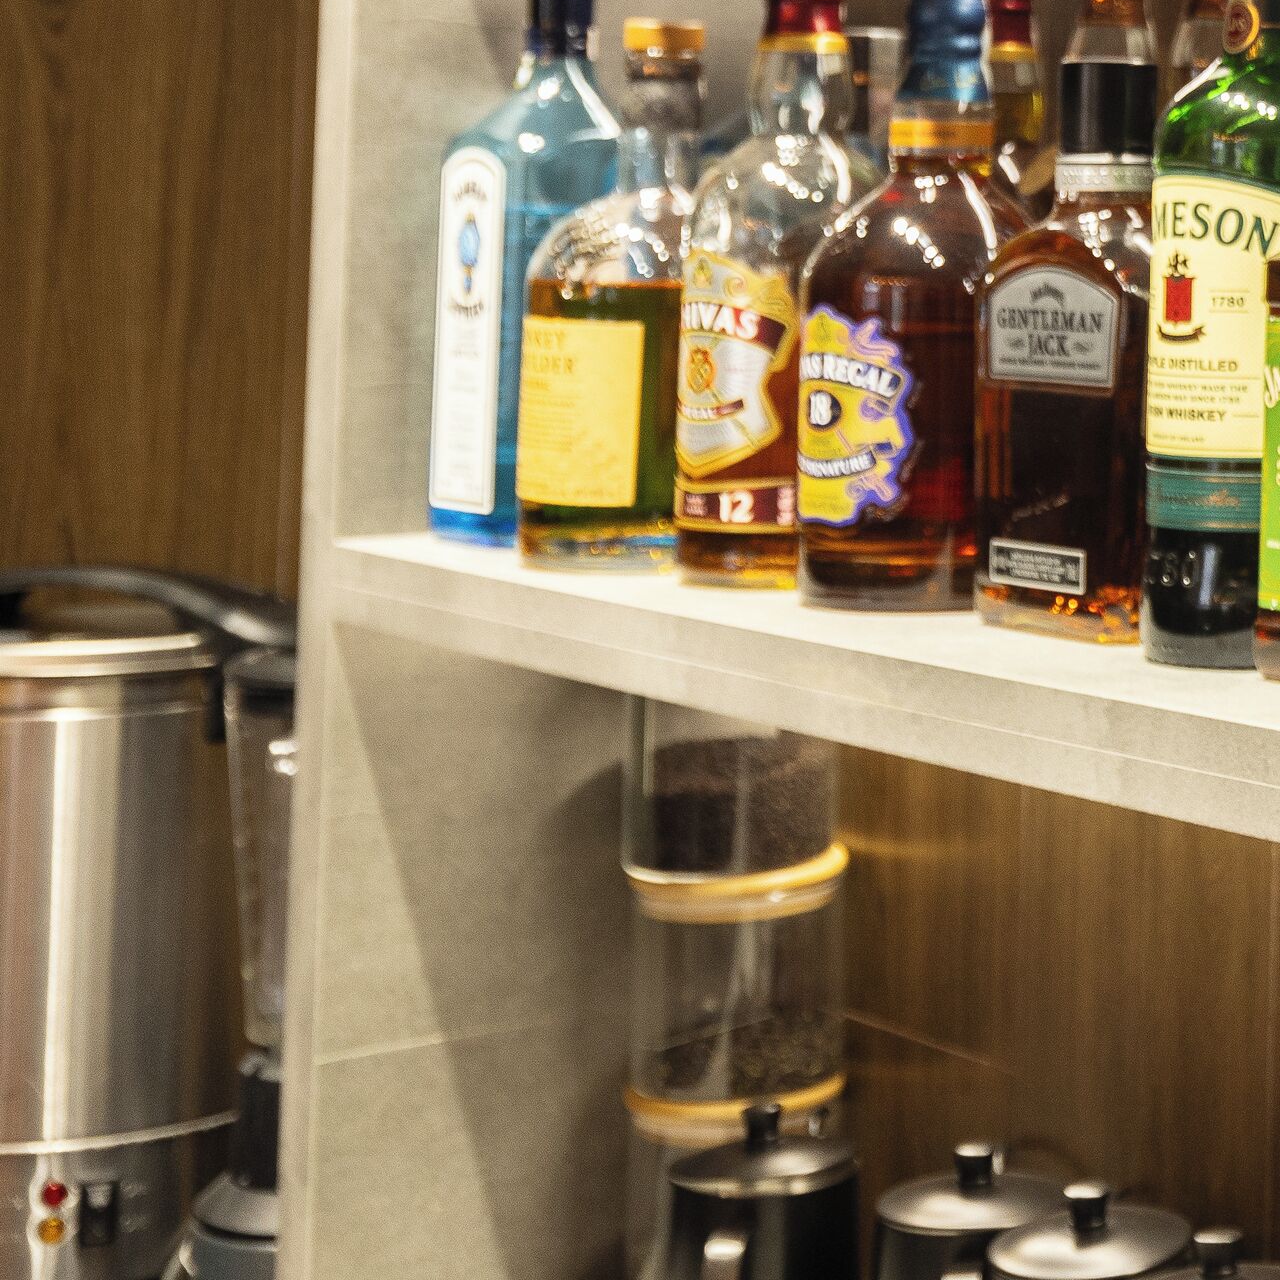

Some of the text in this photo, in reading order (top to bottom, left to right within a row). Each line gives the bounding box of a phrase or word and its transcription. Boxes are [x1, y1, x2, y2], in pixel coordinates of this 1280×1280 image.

[1153, 201, 1279, 257] MESON
[681, 302, 761, 341] HIVAS
[997, 307, 1102, 334] GENTLEMAN
[1028, 333, 1070, 358] JACK
[1169, 358, 1239, 373] DISTILLED
[809, 391, 833, 426] 18
[1166, 407, 1226, 422] WHISKEY
[719, 490, 754, 524] 12
